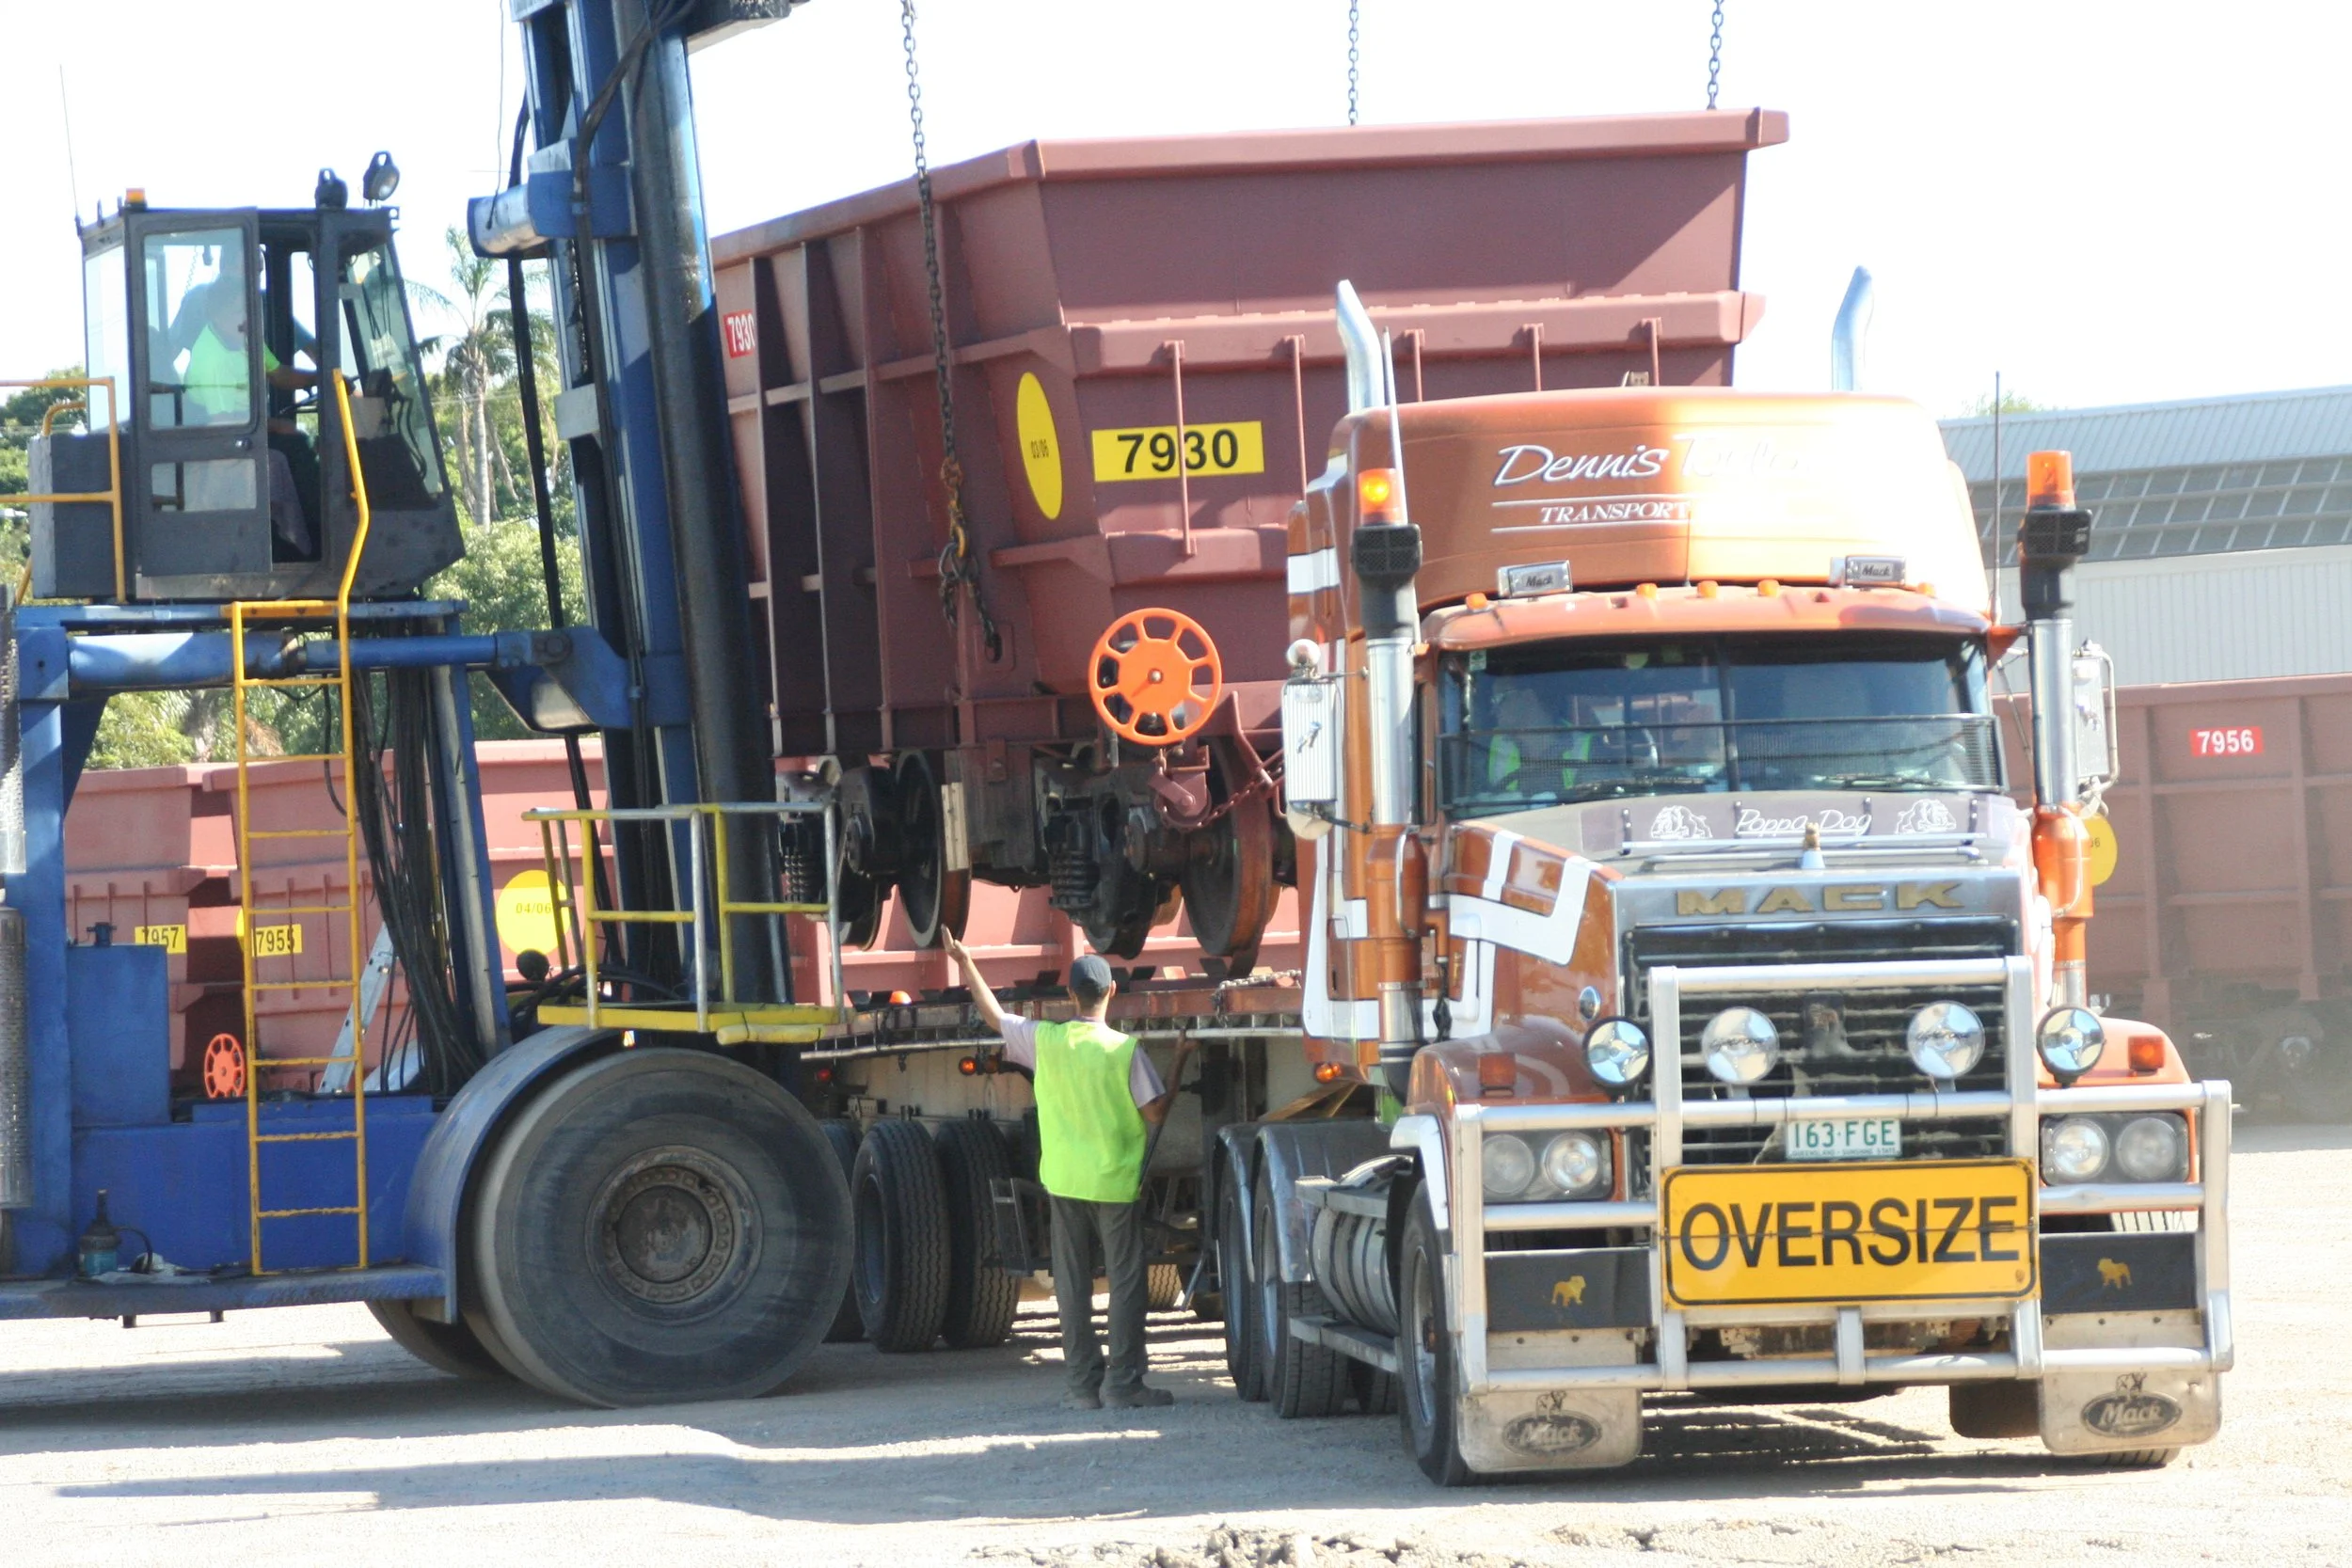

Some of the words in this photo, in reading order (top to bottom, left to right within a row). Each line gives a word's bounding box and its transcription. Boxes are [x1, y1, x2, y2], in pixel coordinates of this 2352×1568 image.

[1117, 429, 1239, 474] 7930
[1493, 443, 1670, 488] Dennis
[1540, 500, 1691, 524] TRANSPORT
[2197, 729, 2255, 753] 7956
[1818, 809, 1873, 836] Dog
[516, 902, 552, 914] 04/06
[1677, 881, 1966, 916] MACK
[1680, 1196, 2019, 1271] OVERSIZE
